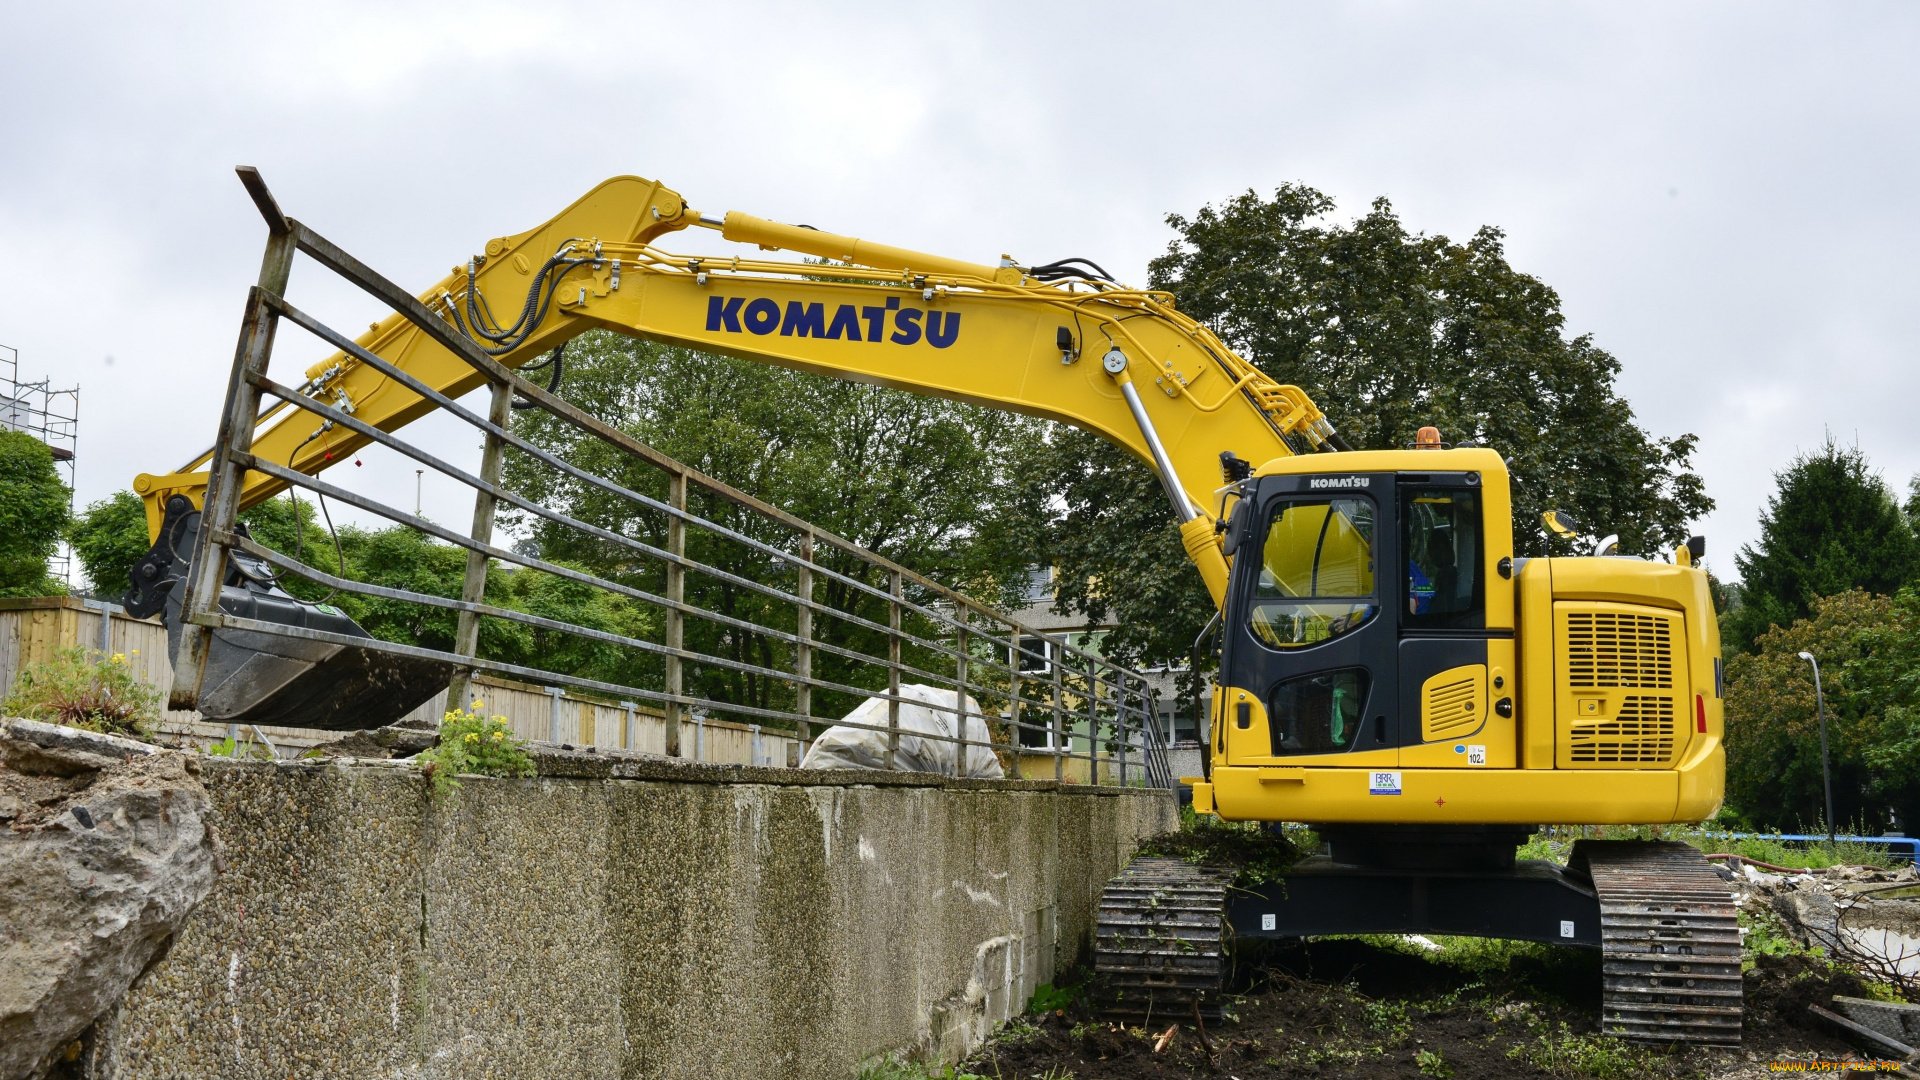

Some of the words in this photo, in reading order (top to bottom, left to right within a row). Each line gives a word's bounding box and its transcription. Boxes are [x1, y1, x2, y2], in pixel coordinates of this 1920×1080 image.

[705, 295, 961, 349] KOMATSU
[1310, 475, 1370, 489] KOMATSU
[1469, 753, 1480, 764] 102
